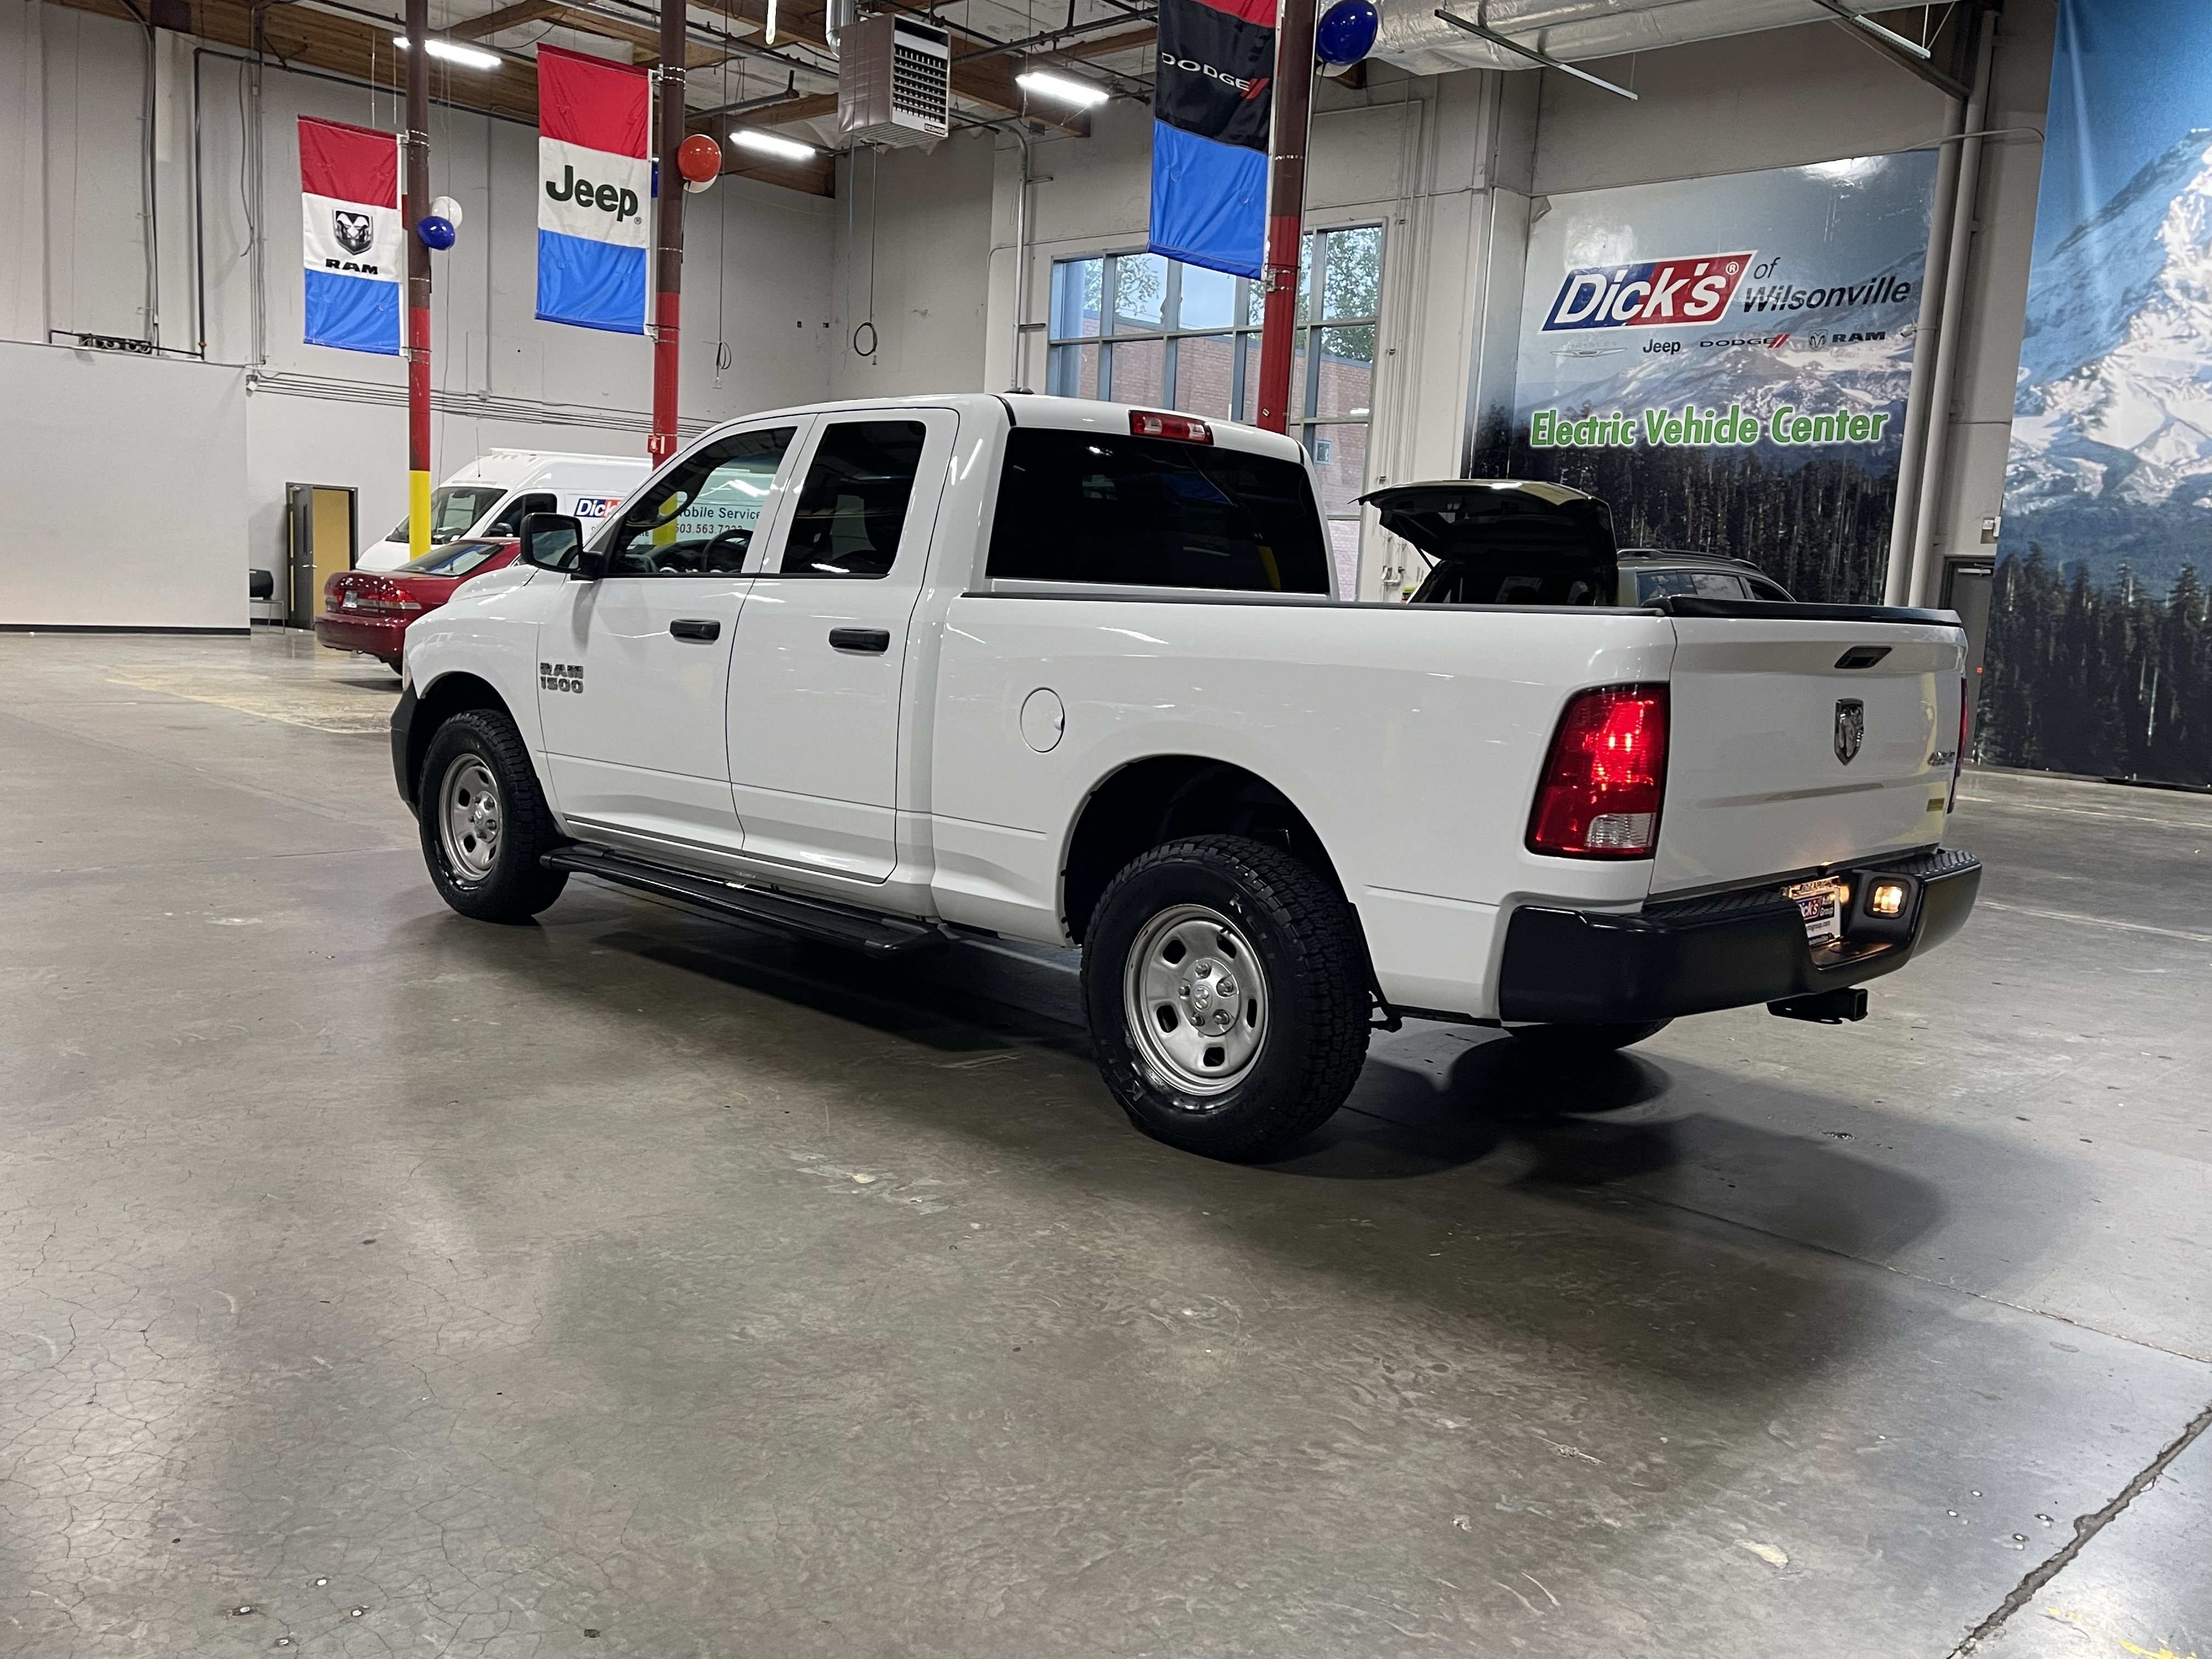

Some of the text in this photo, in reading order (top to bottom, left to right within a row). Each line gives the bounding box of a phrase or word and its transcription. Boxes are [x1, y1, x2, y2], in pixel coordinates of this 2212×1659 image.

[1161, 52, 1251, 92] DODGE
[546, 165, 638, 222] Jeep
[325, 258, 378, 275] RAM
[1554, 257, 1781, 324] Dick's of
[1743, 275, 1911, 313] Wilsonville
[1643, 338, 1681, 355] Jeep
[1700, 337, 1776, 348] DODGE
[1832, 331, 1886, 343] RAM
[1532, 405, 1888, 445] Electric Vehicle Center
[540, 662, 584, 679] RAM
[540, 676, 584, 693] 1500
[1799, 900, 1819, 917] ick's
